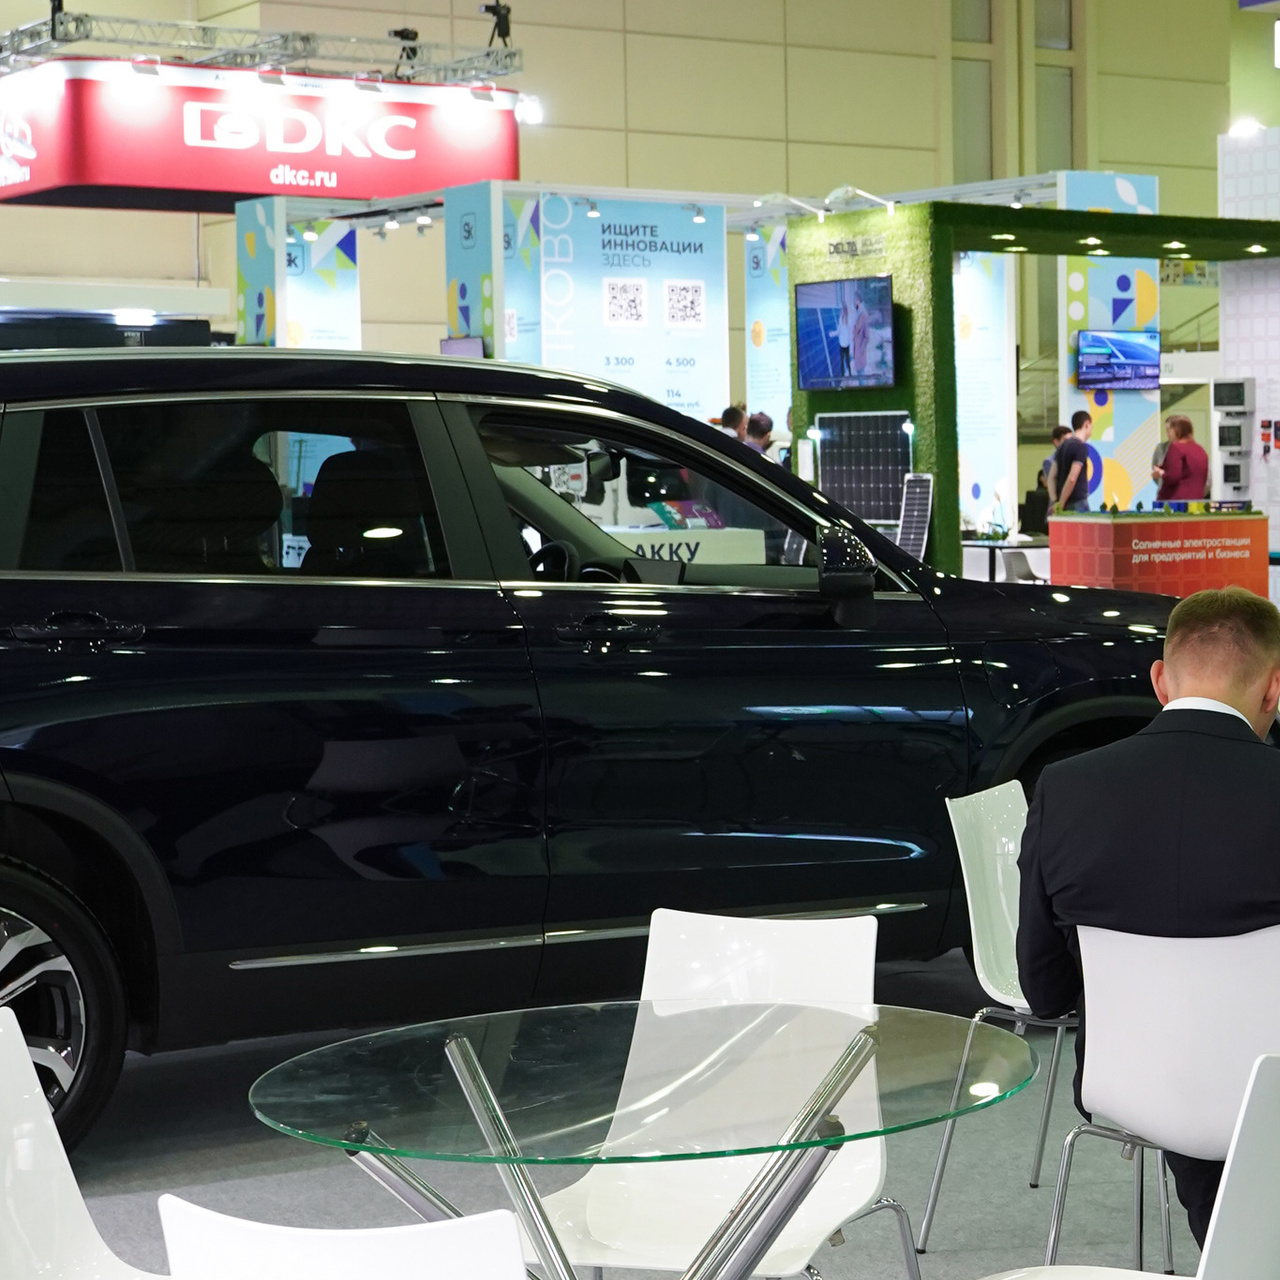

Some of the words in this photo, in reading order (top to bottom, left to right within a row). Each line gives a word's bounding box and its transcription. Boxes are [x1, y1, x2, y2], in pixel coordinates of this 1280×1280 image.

[264, 106, 417, 160] DKC
[269, 164, 338, 187] dkc.ru
[601, 223, 659, 238] ИЩИТЕ
[601, 239, 704, 255] ИННОВАЦИИ
[601, 252, 652, 269] ЗДЕСЬ
[666, 389, 682, 399] 114
[1131, 538, 1181, 551] Солнечные
[1183, 537, 1251, 549] электростанции
[1131, 553, 1149, 564] для
[1150, 549, 1206, 564] предприятий
[1208, 550, 1214, 559] и
[1215, 548, 1250, 559] бизнеса
